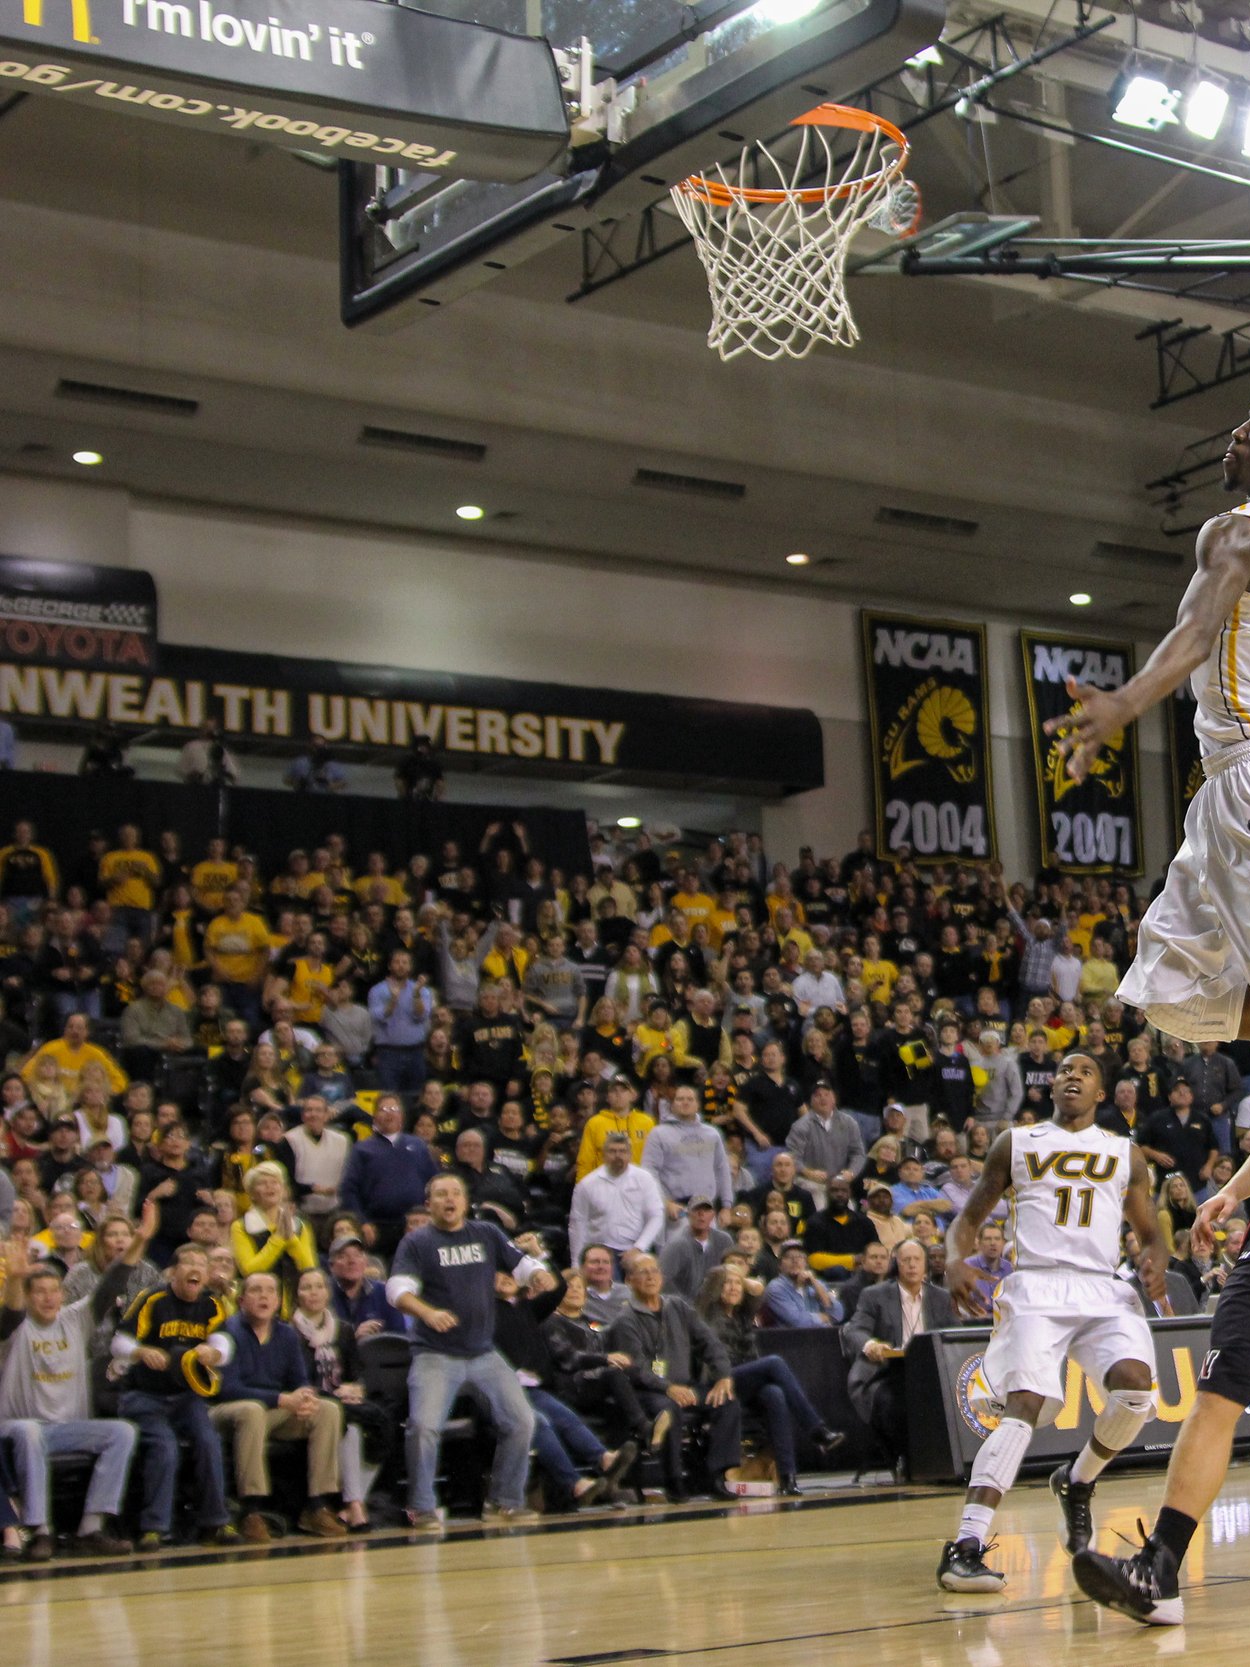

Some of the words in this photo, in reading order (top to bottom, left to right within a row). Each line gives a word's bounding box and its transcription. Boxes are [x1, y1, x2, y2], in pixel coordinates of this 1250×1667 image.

[200, 0, 321, 62] lovin'
[874, 627, 977, 676] NCAA
[1034, 644, 1127, 690] NCAA
[307, 694, 625, 765] UNIVERSITY
[885, 798, 987, 856] 2004
[1050, 811, 1131, 865] 2007
[1024, 1151, 1119, 1184] VCU
[1053, 1186, 1095, 1229] 11
[437, 1243, 484, 1267] RAMS
